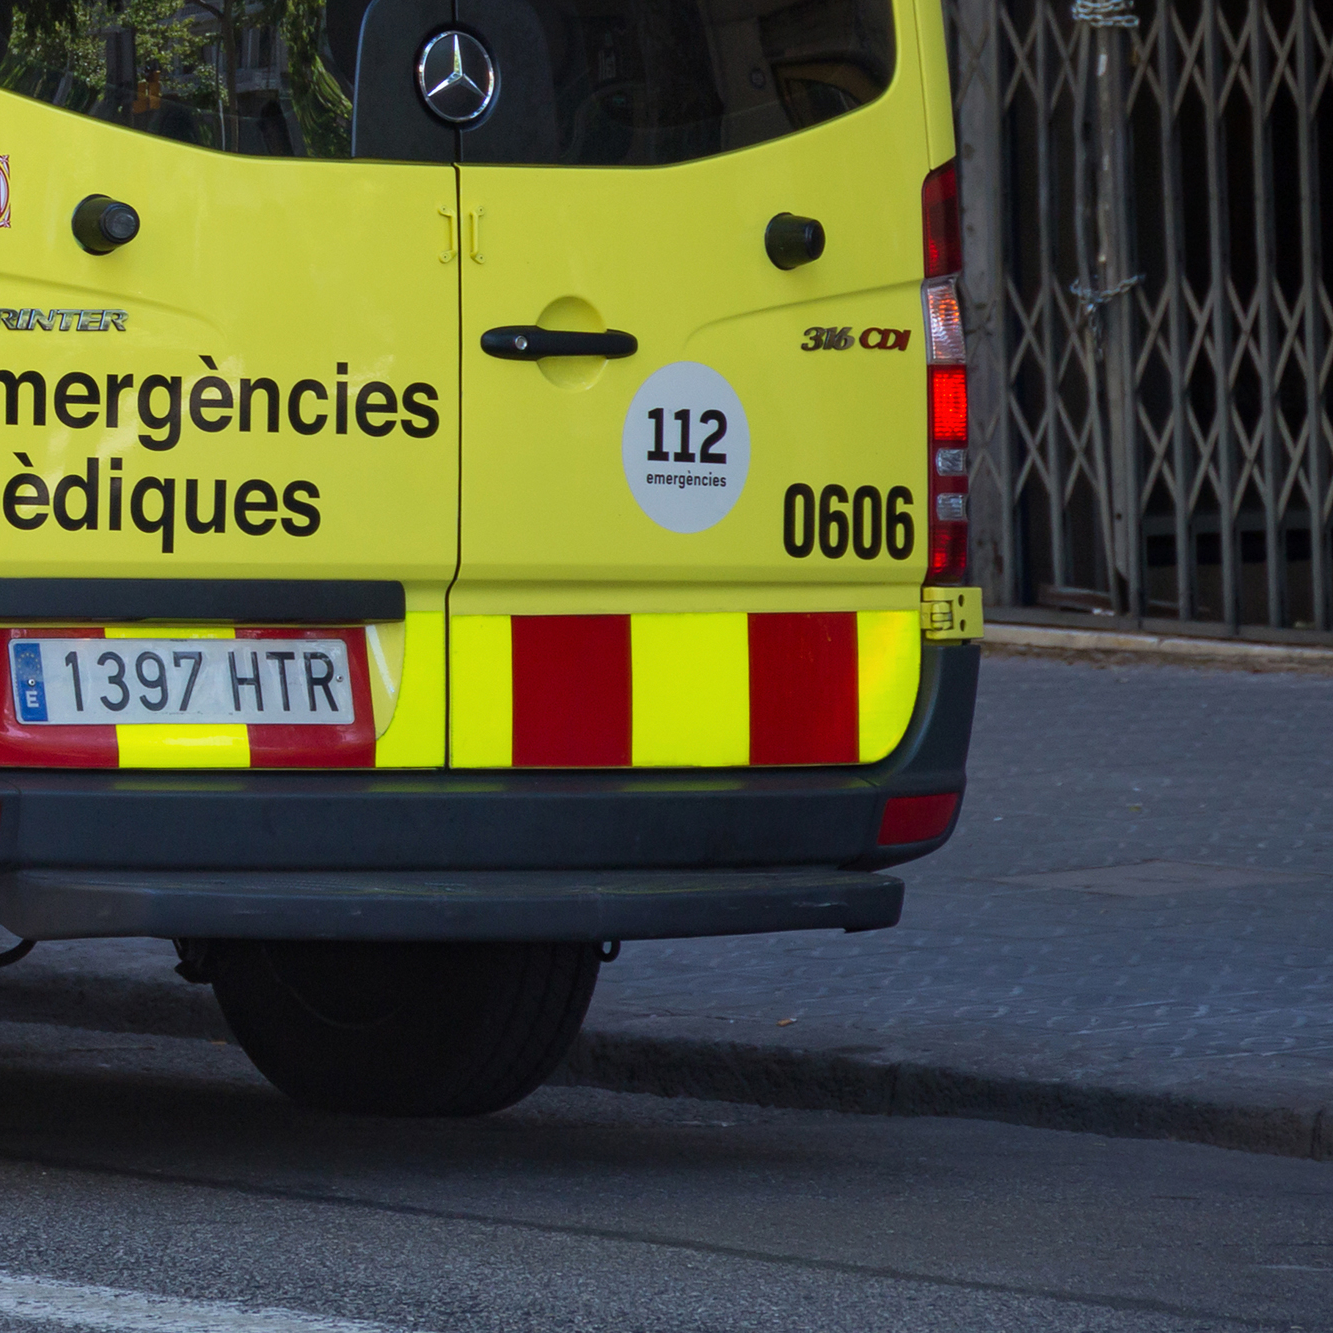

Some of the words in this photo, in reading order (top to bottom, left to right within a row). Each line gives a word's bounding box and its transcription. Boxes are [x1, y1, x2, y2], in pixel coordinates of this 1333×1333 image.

[801, 326, 856, 351] 316
[859, 327, 912, 351] CDI
[646, 407, 728, 464] 112
[645, 470, 727, 489] emergències
[783, 483, 915, 560] 0606
[25, 690, 39, 708] E
[64, 650, 203, 712] 1397
[229, 651, 339, 712] HTR
